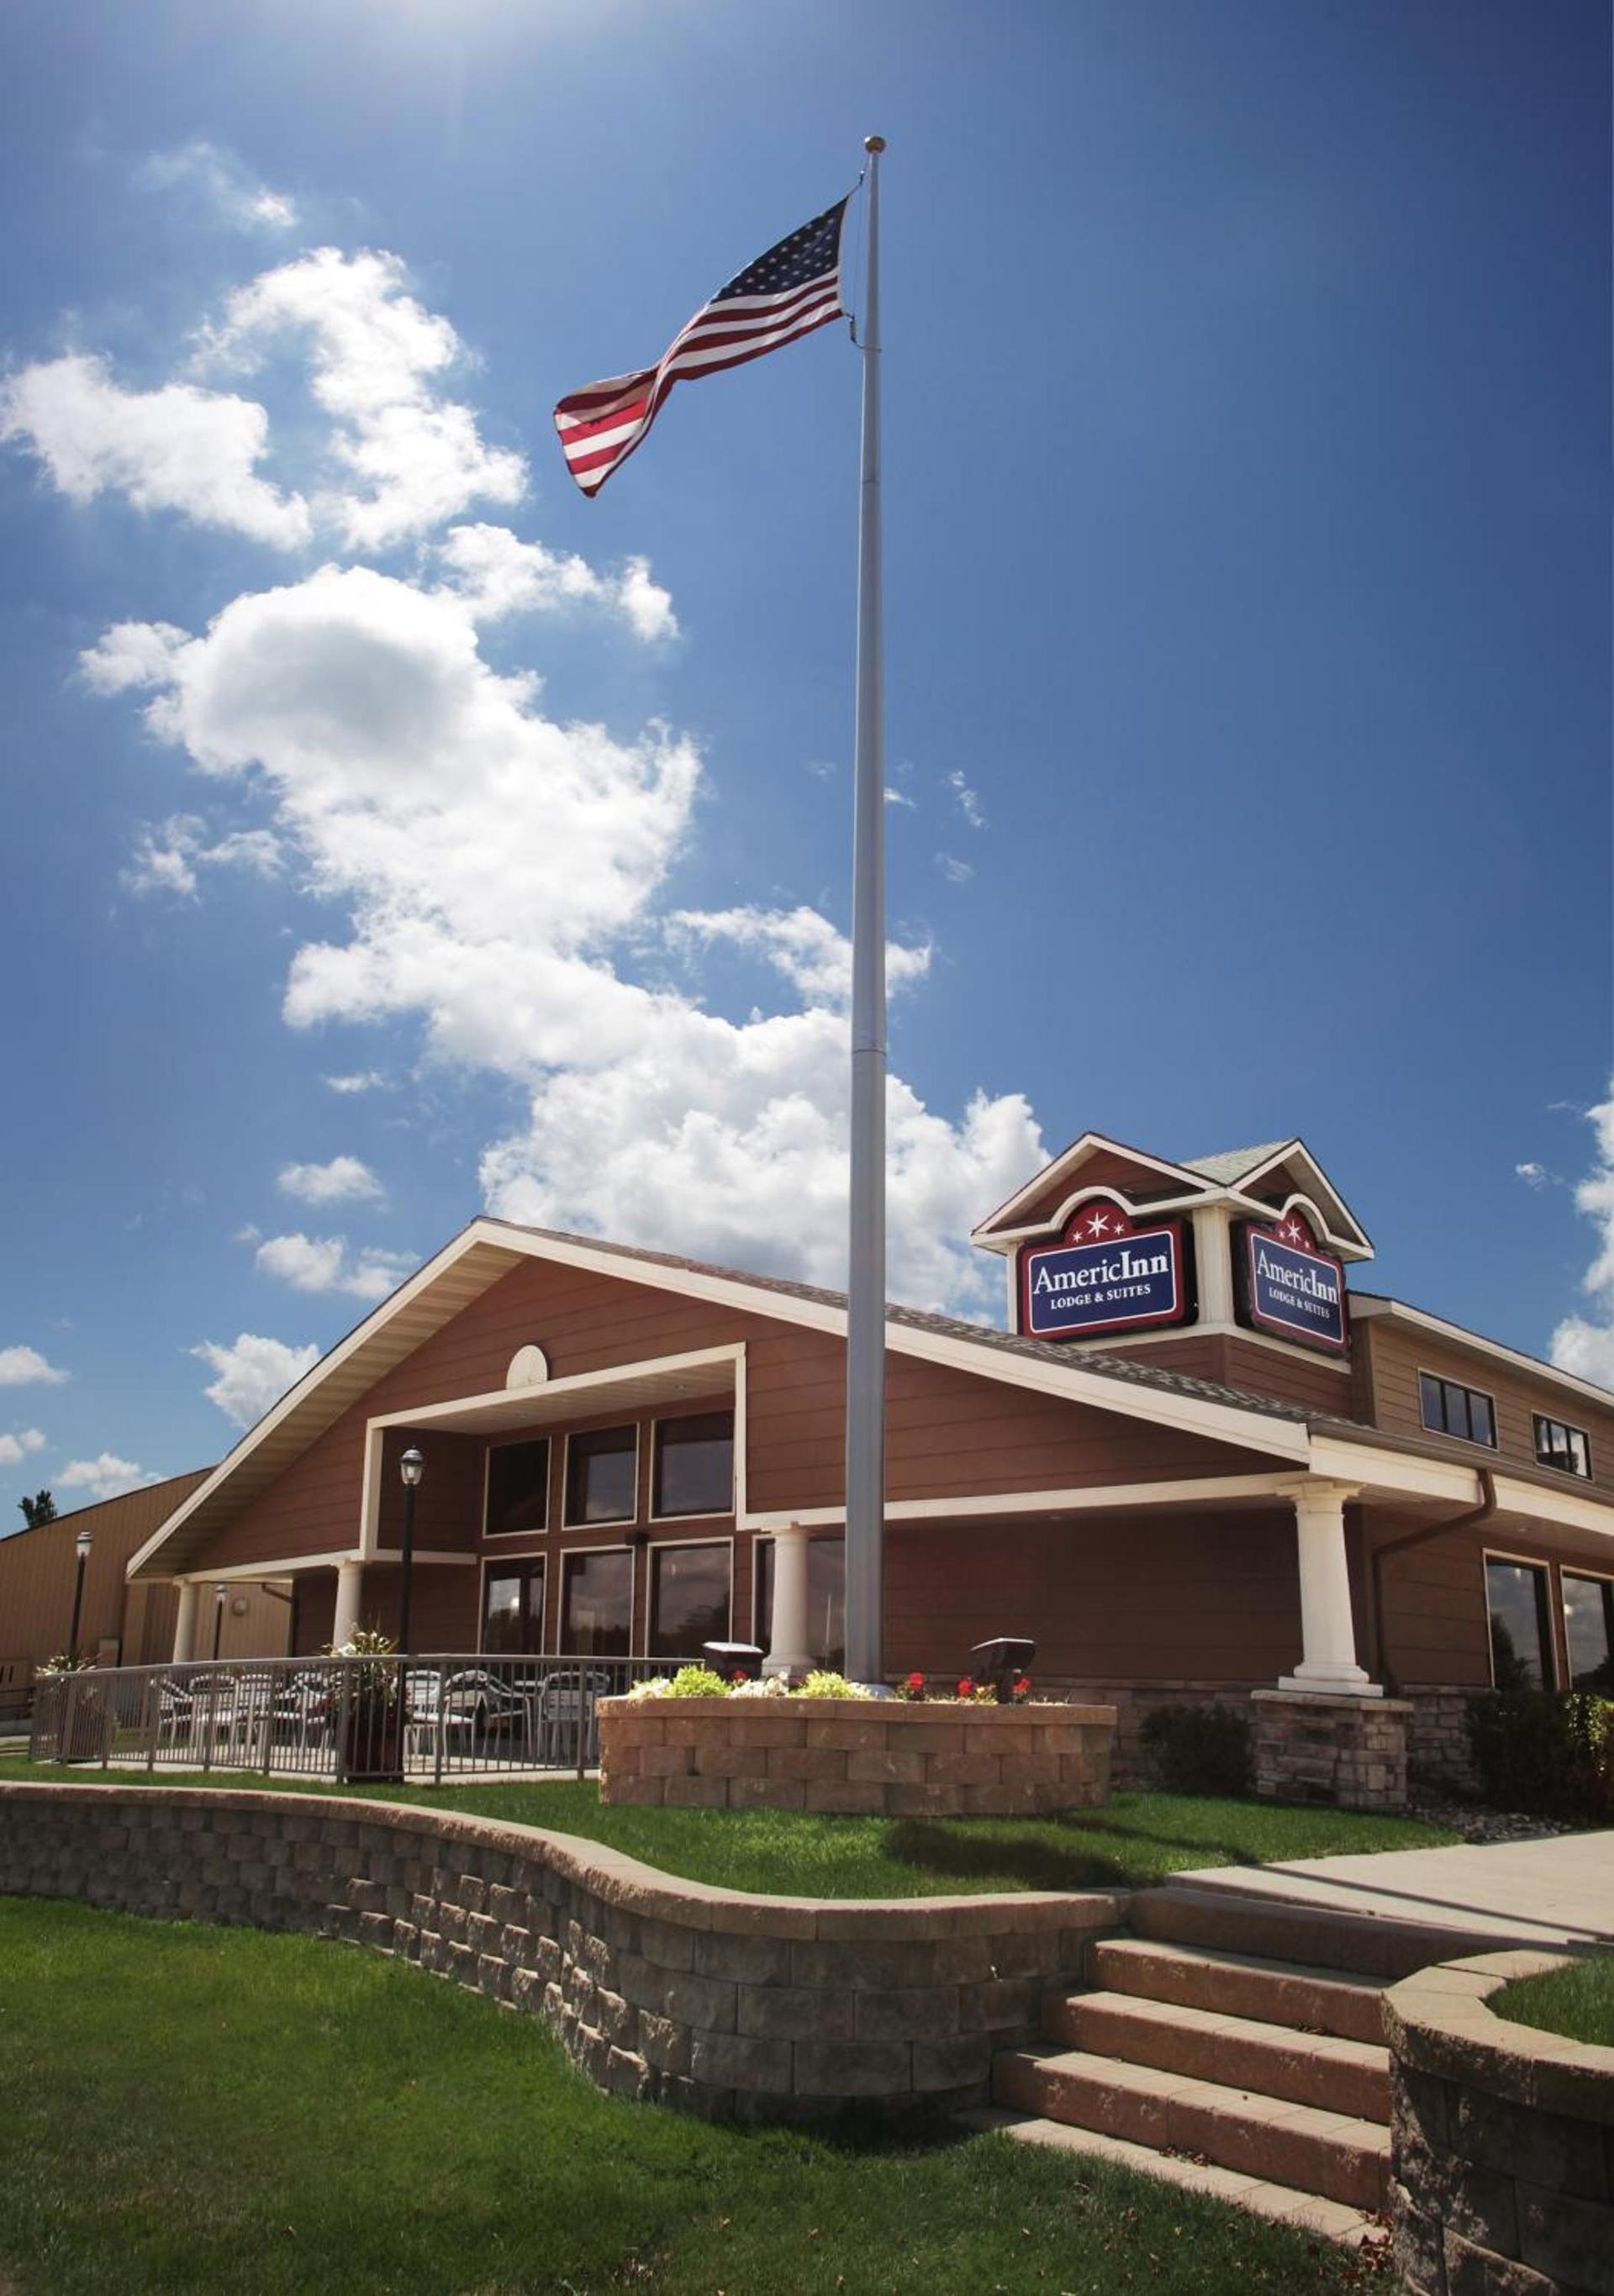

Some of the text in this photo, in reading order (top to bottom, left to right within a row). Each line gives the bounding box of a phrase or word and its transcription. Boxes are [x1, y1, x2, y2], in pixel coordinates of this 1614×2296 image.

[1033, 1251, 1168, 1294] AmericInn
[1258, 1249, 1338, 1304] AmericInn
[1051, 1284, 1151, 1309] LODGE & SUITES
[1269, 1287, 1330, 1319] LODGE & SUITES
